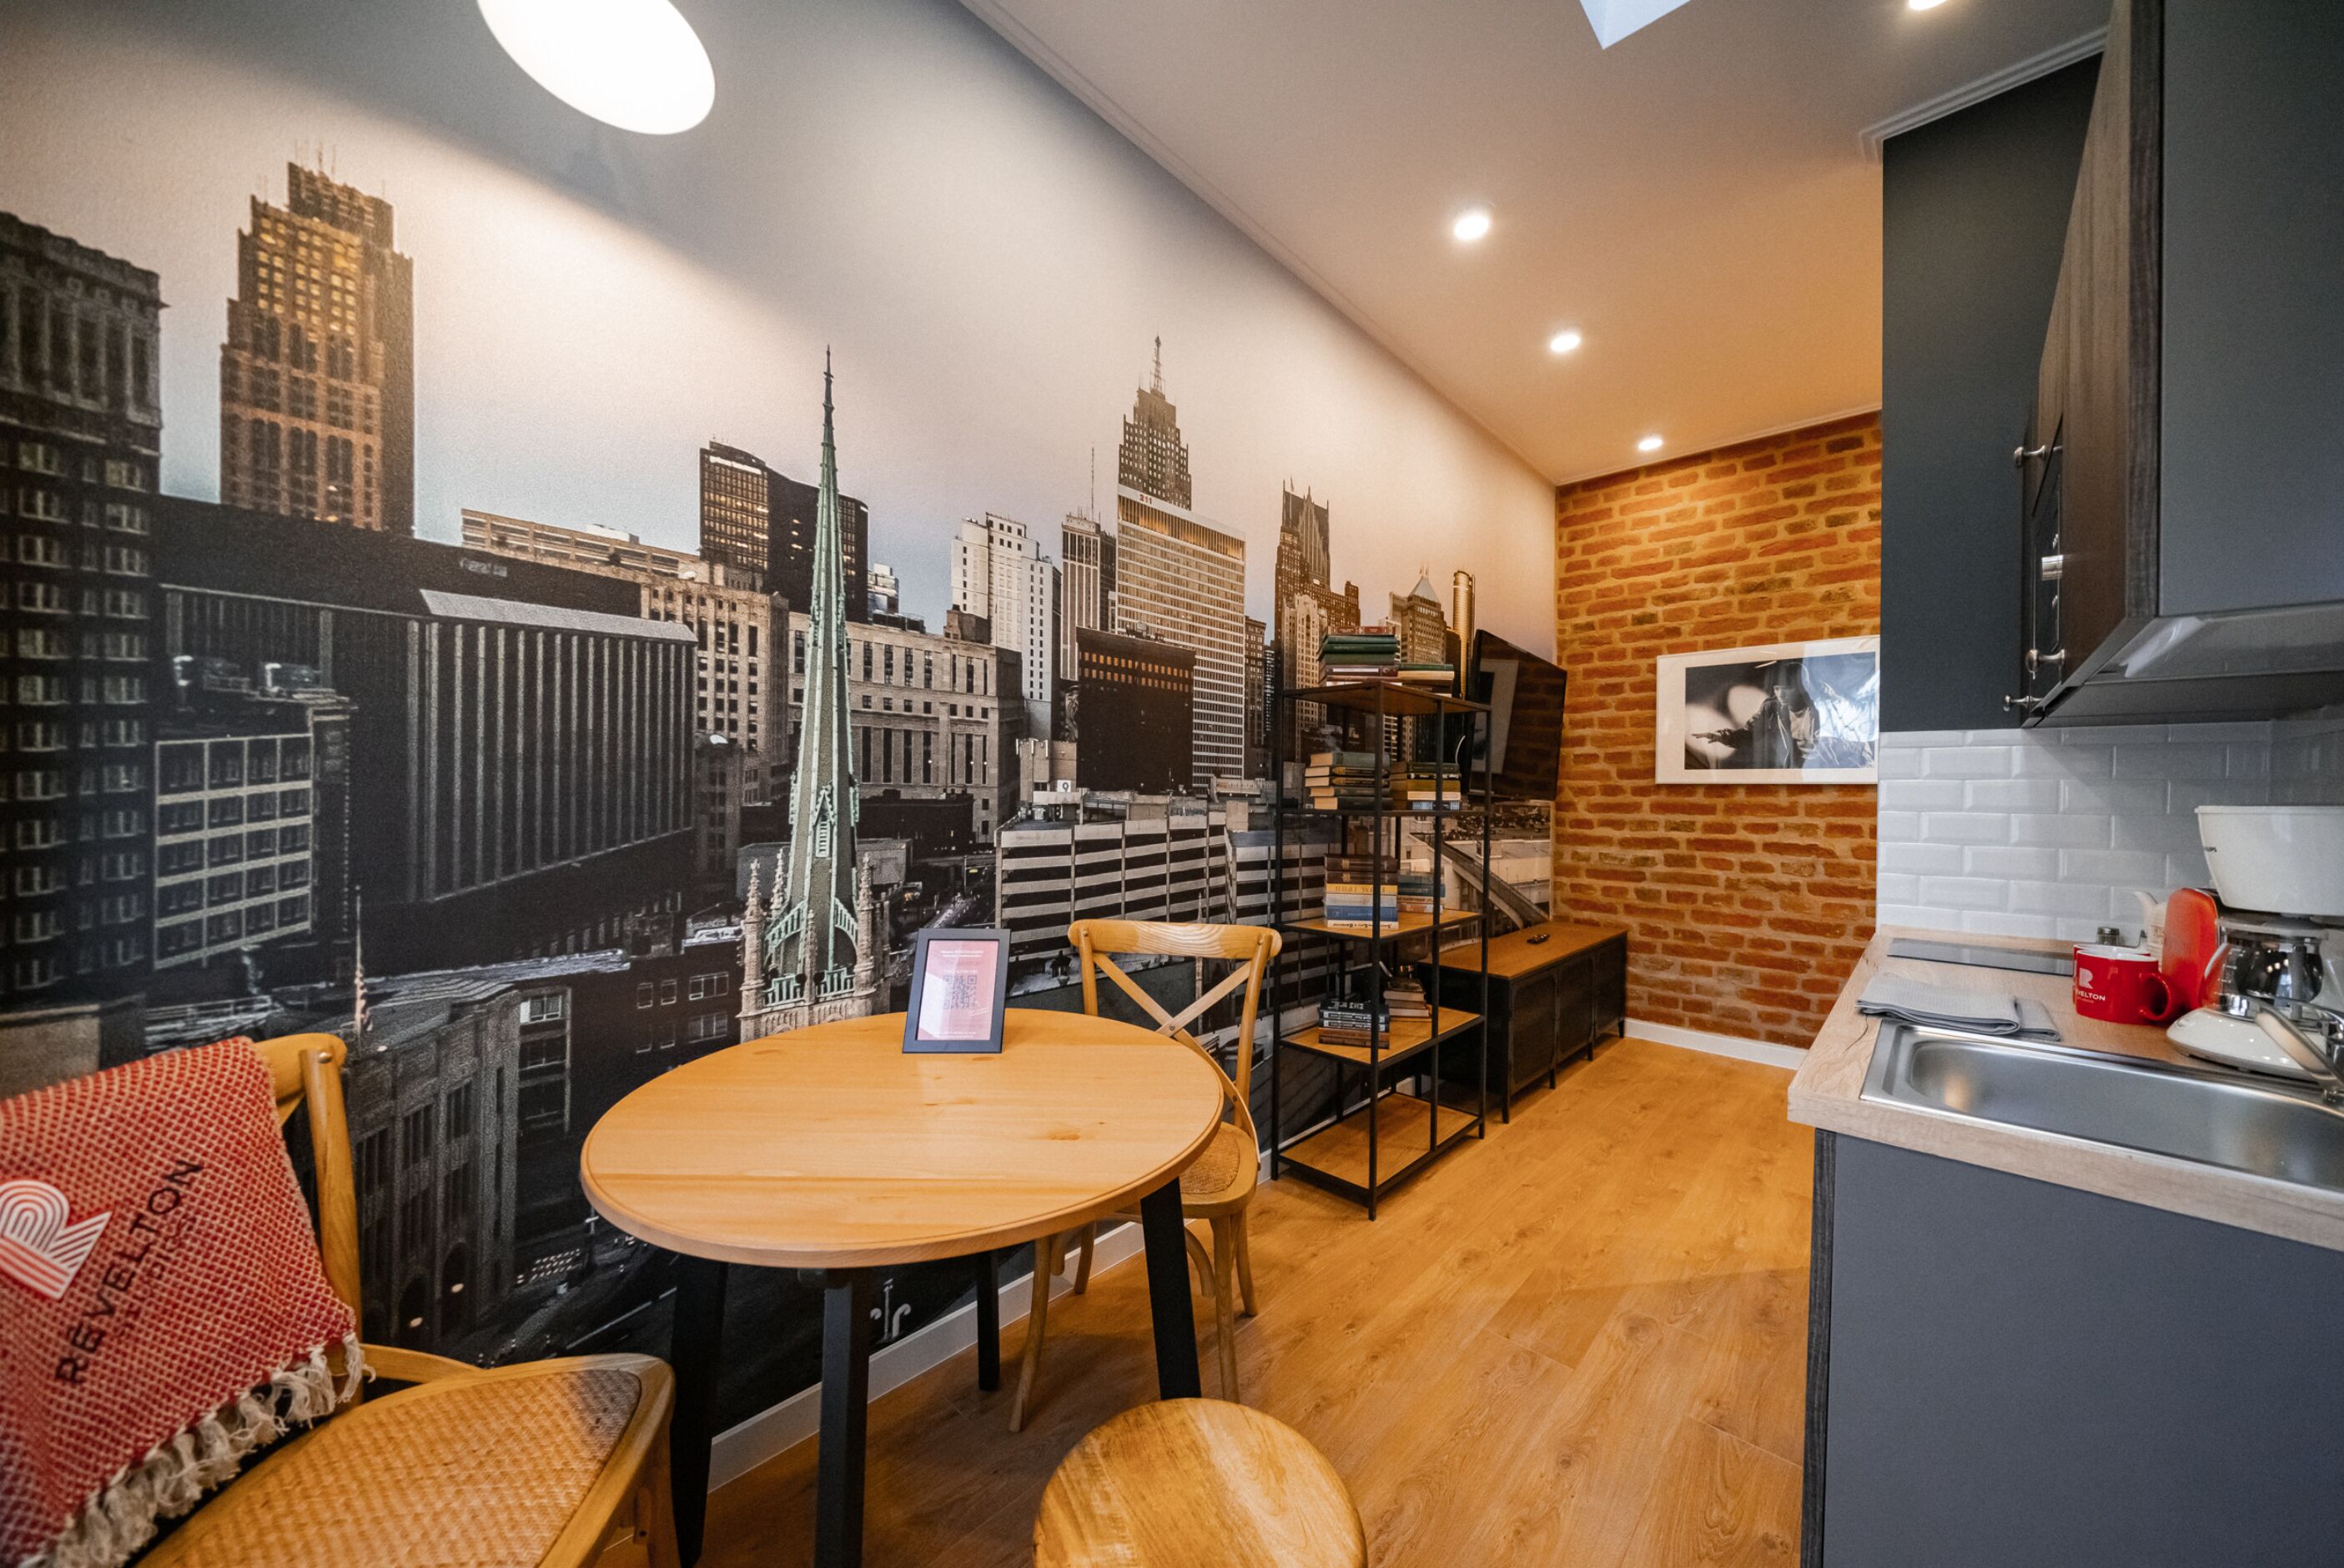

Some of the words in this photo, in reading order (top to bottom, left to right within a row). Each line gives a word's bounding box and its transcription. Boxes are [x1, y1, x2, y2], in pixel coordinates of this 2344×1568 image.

[1139, 494, 1152, 505] 211
[1062, 781, 1069, 793] 9
[55, 1160, 204, 1385] REVELTON
